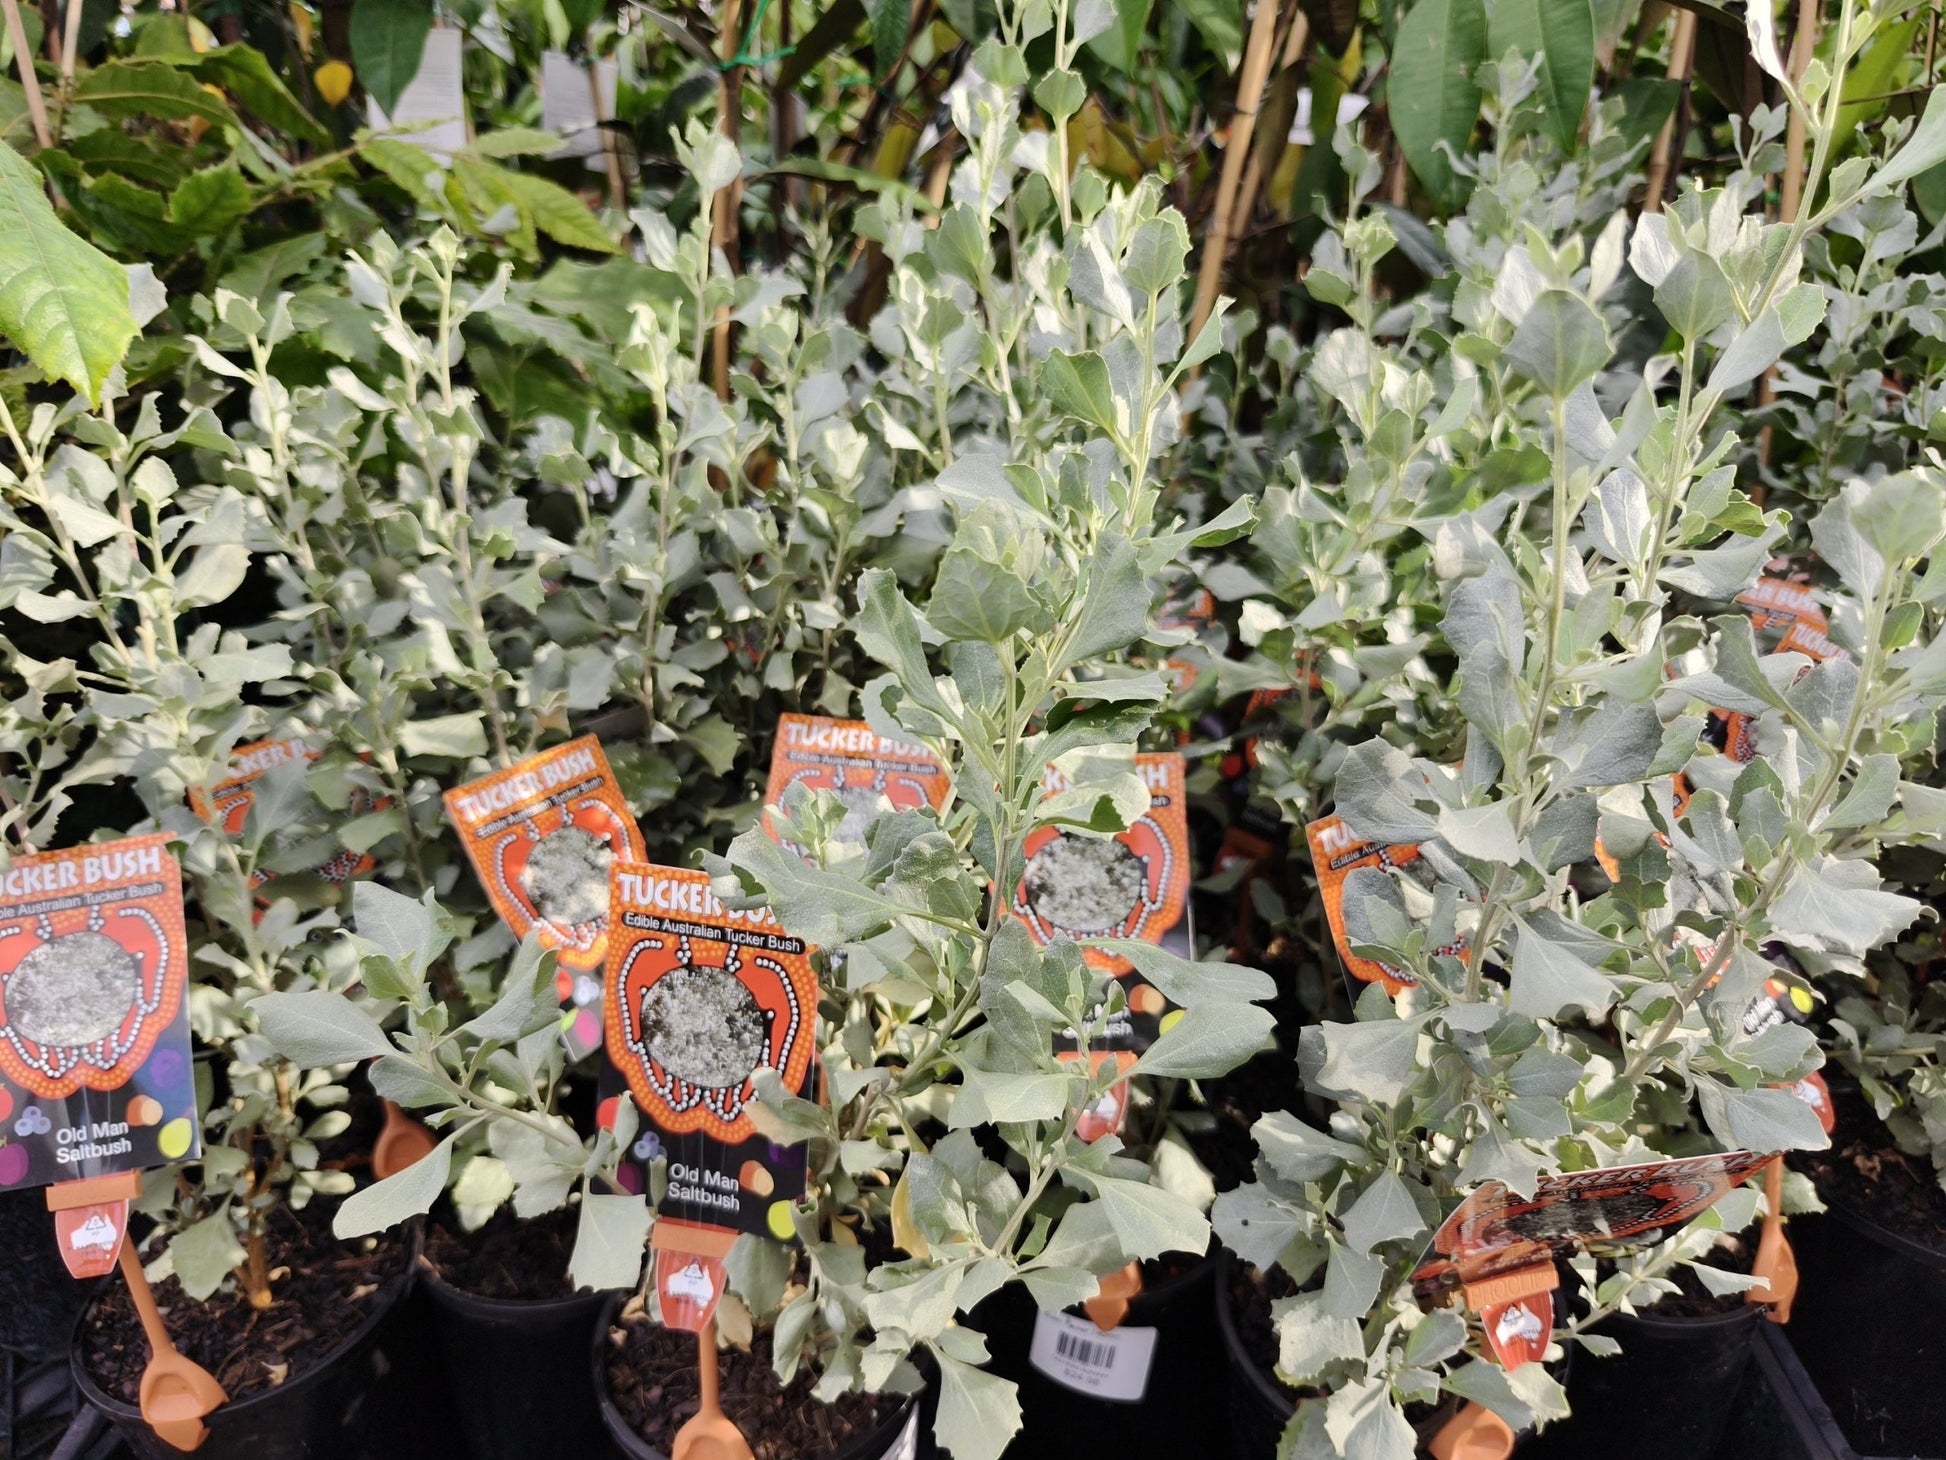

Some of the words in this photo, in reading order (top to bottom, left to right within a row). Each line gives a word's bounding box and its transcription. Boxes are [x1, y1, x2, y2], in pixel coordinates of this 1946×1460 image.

[787, 724, 874, 752] TUCKER
[456, 771, 544, 823] TUCKER
[541, 747, 597, 788] BUSH
[83, 846, 161, 885] BUSH
[18, 891, 82, 916] Australian
[86, 886, 127, 904] Tucker
[129, 882, 163, 898] Bush
[625, 912, 660, 930] Edible
[661, 919, 722, 939] Australian
[725, 928, 765, 945] Tucker
[768, 936, 801, 953] Bush
[56, 1125, 88, 1145] Old
[92, 1121, 130, 1139] Man
[56, 1138, 133, 1164] Saltbush
[669, 1162, 700, 1184] Old
[704, 1168, 740, 1193] Man
[667, 1181, 740, 1212] Saltbush
